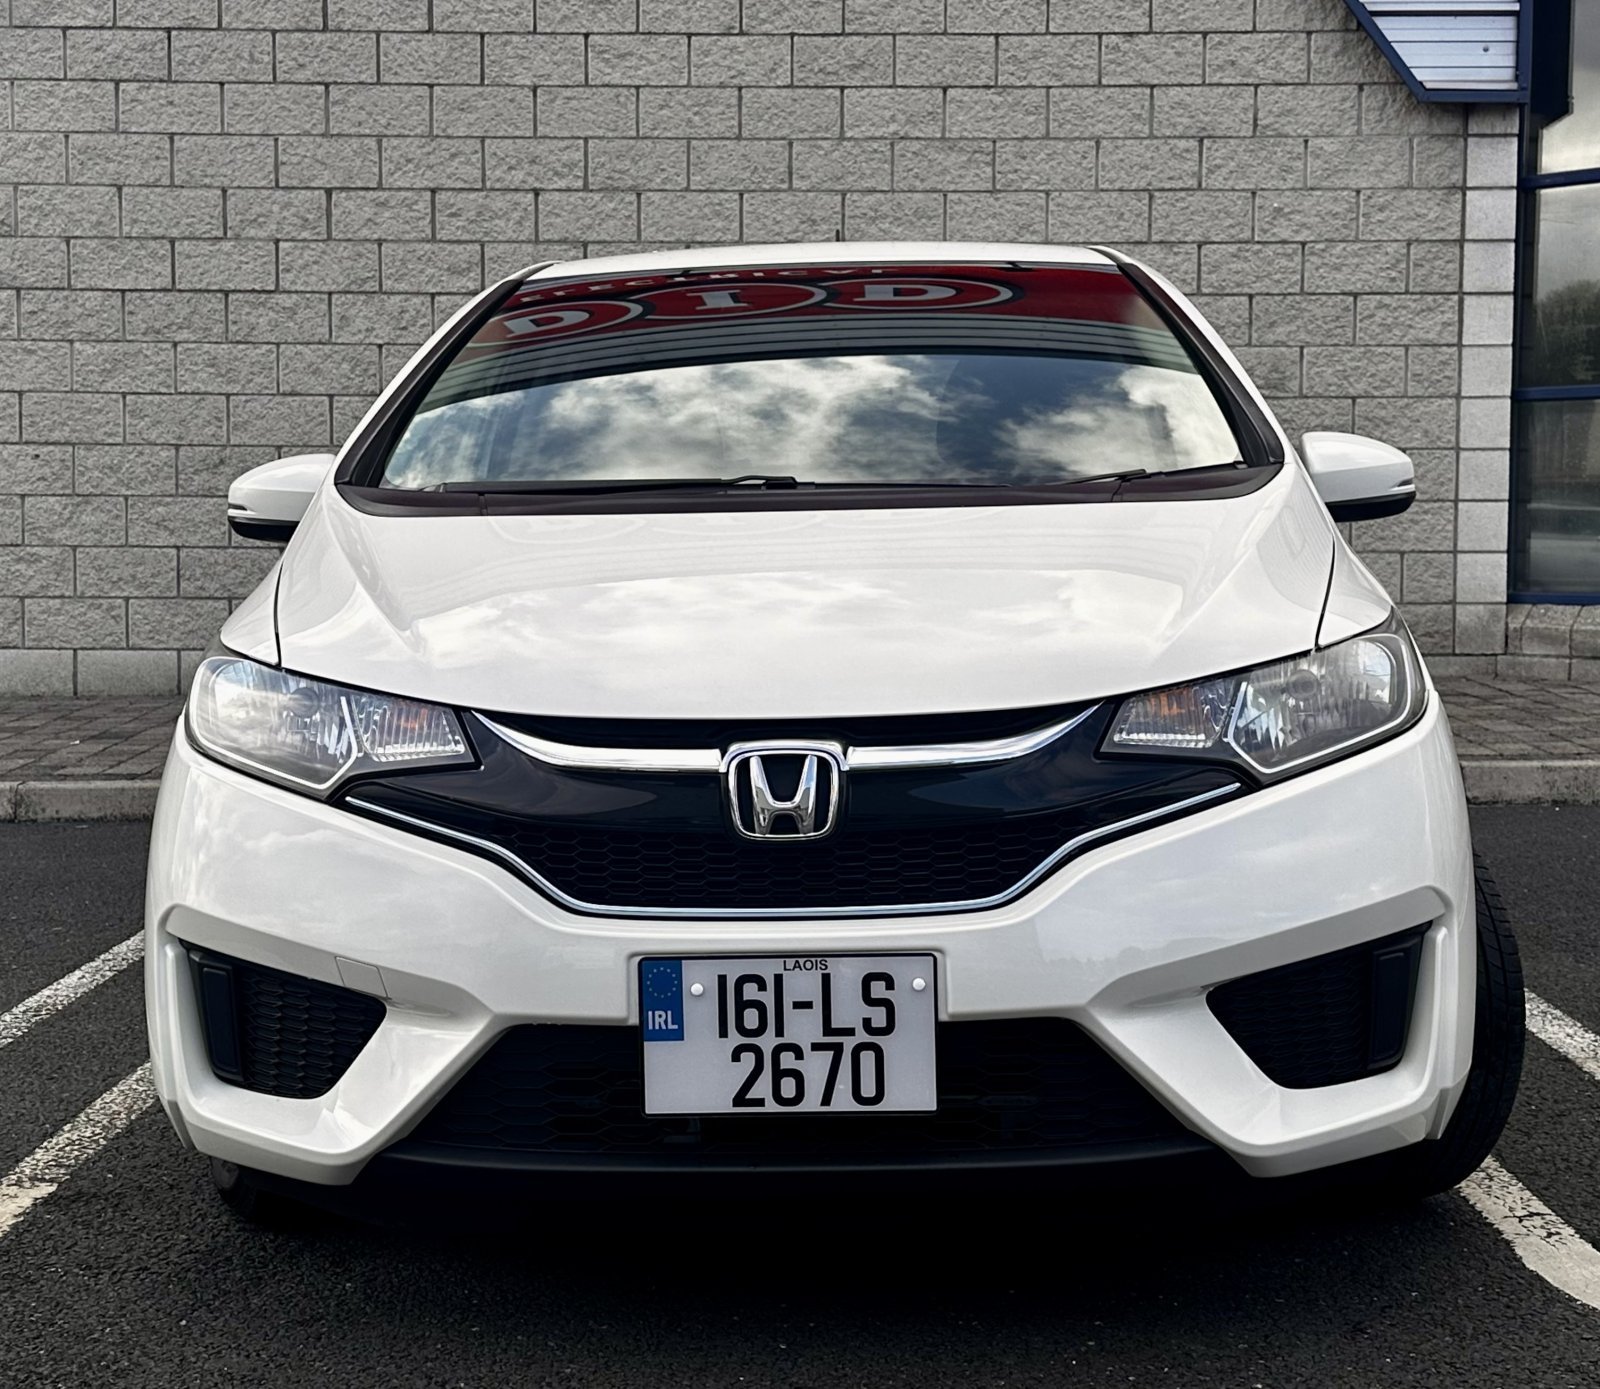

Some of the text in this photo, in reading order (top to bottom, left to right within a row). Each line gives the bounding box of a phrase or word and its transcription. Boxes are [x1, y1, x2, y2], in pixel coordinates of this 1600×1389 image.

[783, 959, 828, 971] LAOIS
[648, 1010, 678, 1030] IRL
[717, 972, 896, 1038] 161-LS
[731, 1041, 885, 1107] 2670
